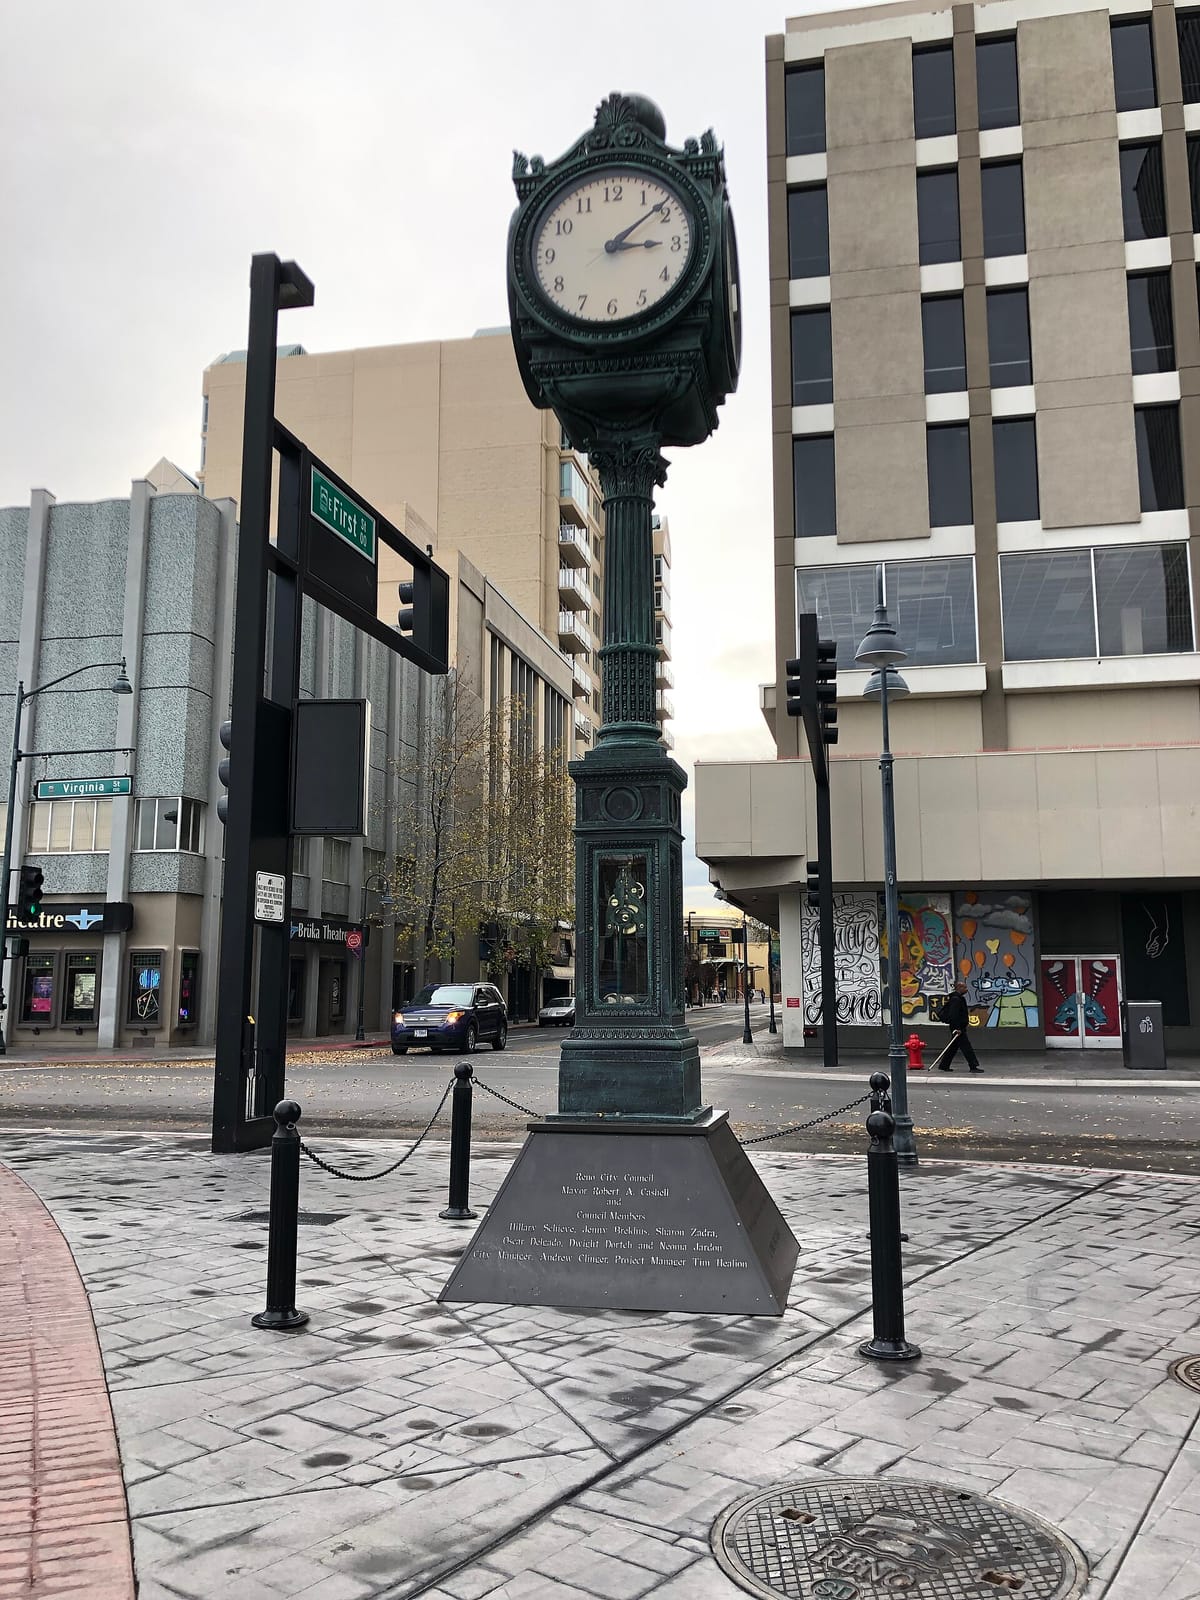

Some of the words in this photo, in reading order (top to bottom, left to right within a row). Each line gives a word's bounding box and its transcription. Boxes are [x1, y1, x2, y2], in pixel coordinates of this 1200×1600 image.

[603, 186, 623, 203] 12
[640, 190, 647, 206] 1
[577, 197, 592, 213] 11
[660, 207, 671, 224] 2
[555, 219, 573, 235] 10
[670, 235, 682, 252] 3
[545, 248, 556, 265] 9
[659, 265, 670, 282] 4
[554, 276, 565, 292] 8
[577, 295, 588, 311] 7
[636, 289, 647, 306] 5
[606, 299, 618, 316] 6
[333, 496, 358, 537] First
[63, 782, 105, 795] Virginia
[112, 780, 121, 788] St
[298, 922, 320, 939] Brüka
[575, 1172, 595, 1181] Reno
[600, 1173, 618, 1182] City
[624, 1173, 654, 1183] Council
[561, 1186, 587, 1196] Mayor
[592, 1187, 619, 1196] Robert
[640, 1187, 669, 1198] Cashell
[606, 1198, 622, 1206] and
[576, 1210, 607, 1220] Council
[609, 1211, 646, 1221] Members
[509, 1222, 537, 1232] Hillary
[582, 1225, 608, 1235] Jenny
[655, 1227, 685, 1237] Sharon
[502, 1236, 525, 1246] Oscar
[569, 1238, 600, 1249] Dwight
[605, 1240, 633, 1250] Dortch
[638, 1241, 654, 1250] and
[693, 1243, 723, 1252] Jardon
[473, 1251, 490, 1260] City
[540, 1252, 573, 1262] Andrew
[614, 1255, 645, 1266] Project
[650, 1256, 687, 1268] Manager
[692, 1257, 710, 1267] Tim
[808, 1546, 916, 1590] RENO
